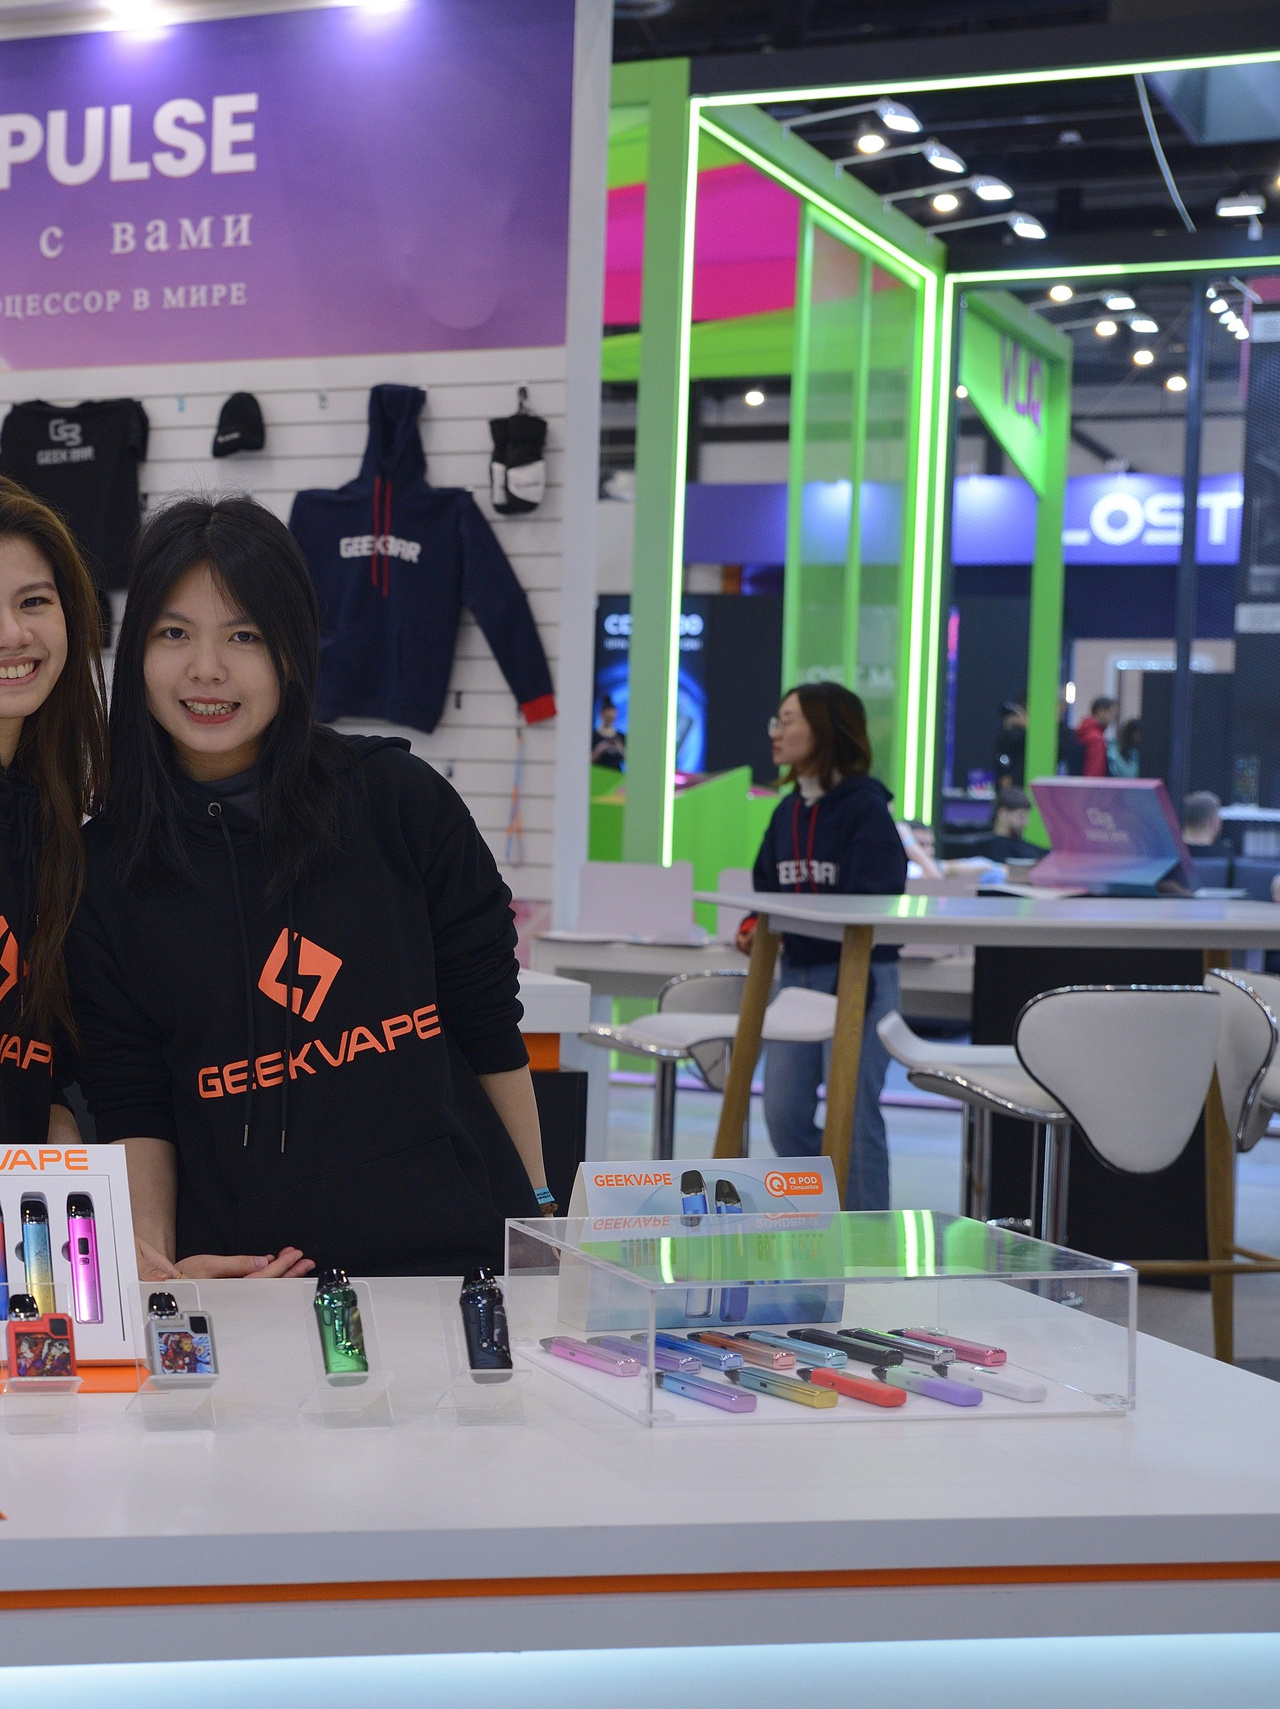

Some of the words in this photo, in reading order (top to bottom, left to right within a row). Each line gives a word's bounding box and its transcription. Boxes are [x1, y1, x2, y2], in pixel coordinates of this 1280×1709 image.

[38, 225, 65, 260] с
[110, 212, 254, 255] вами
[132, 288, 151, 311] В
[162, 282, 248, 310] МИРЕ
[197, 1003, 442, 1099] GEEKVAPE
[593, 1173, 673, 1188] GEEKVAPE
[788, 1177, 797, 1186] Q
[799, 1176, 818, 1185] POD
[789, 1184, 819, 1192] Compatible
